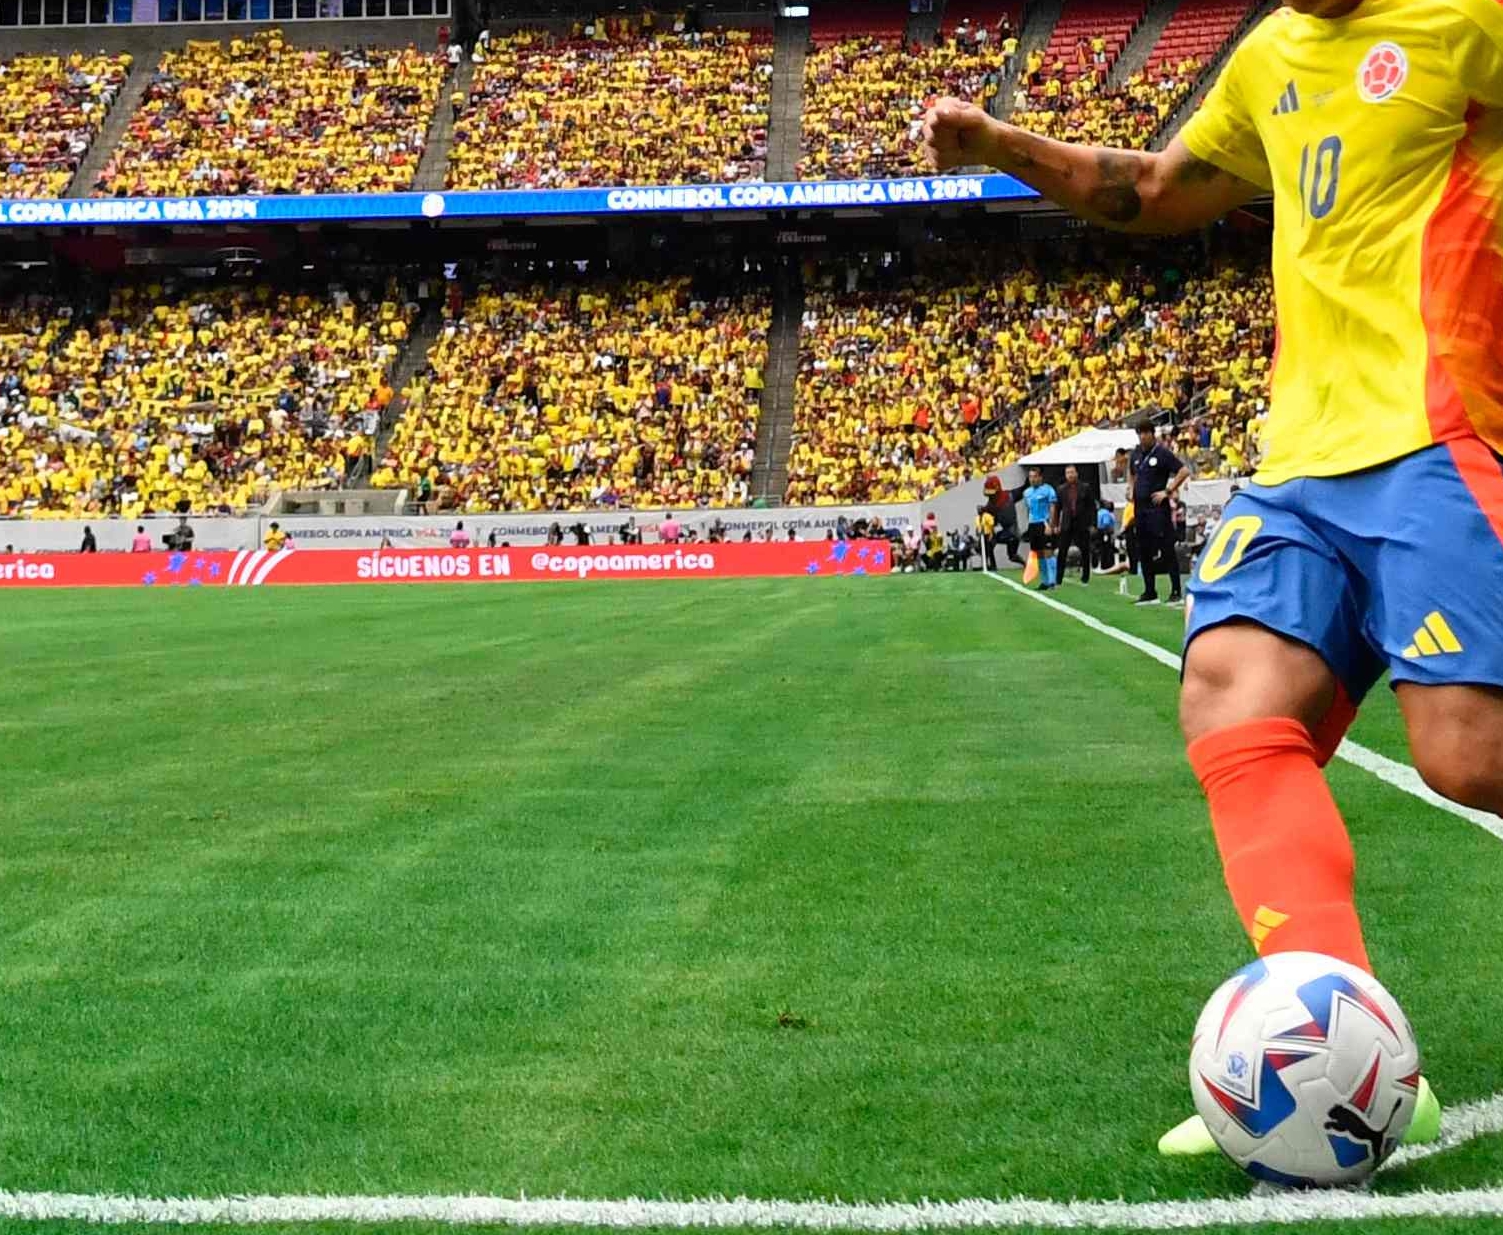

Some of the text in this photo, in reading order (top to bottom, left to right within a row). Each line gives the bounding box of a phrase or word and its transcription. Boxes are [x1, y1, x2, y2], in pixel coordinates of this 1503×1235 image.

[607, 179, 983, 209] CONMEBOL COPA AMERICA USA 2024
[1299, 134, 1342, 228] 10
[8, 202, 69, 223] COPA
[67, 201, 161, 222] AMERICA
[162, 200, 200, 220] USA
[205, 199, 258, 219] 2024
[356, 549, 714, 579] SÍGUENOS EN @copaamerica
